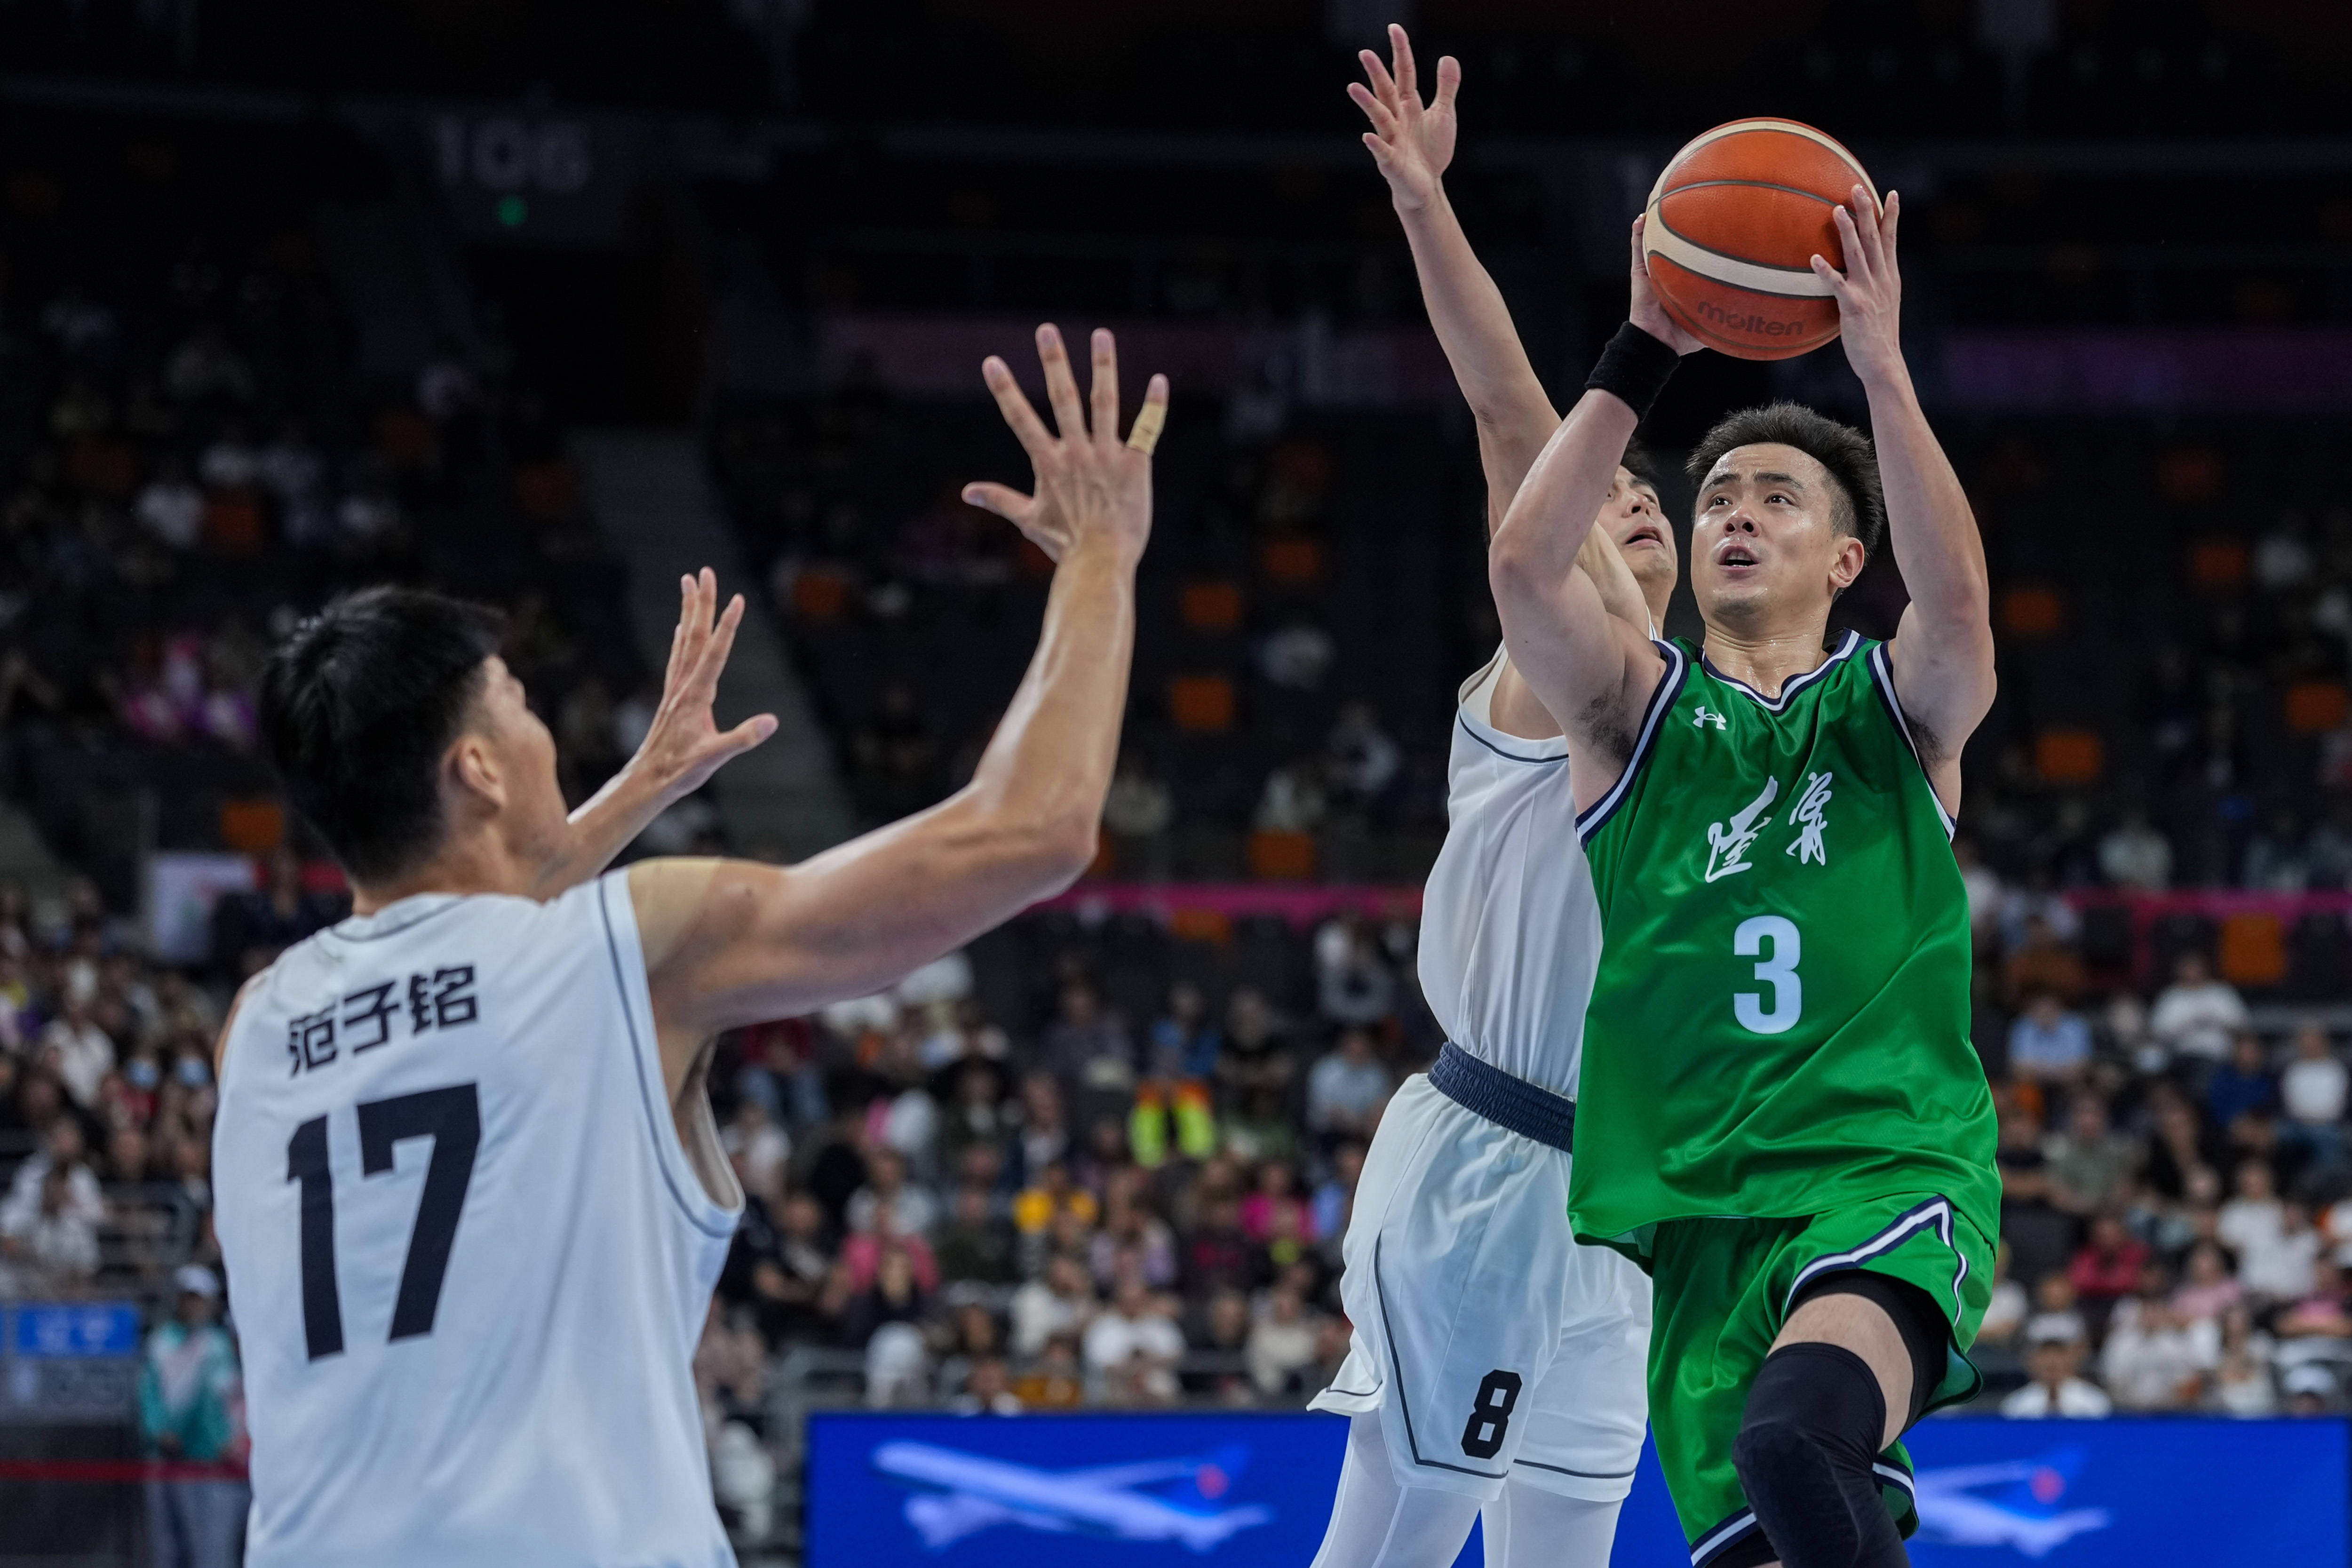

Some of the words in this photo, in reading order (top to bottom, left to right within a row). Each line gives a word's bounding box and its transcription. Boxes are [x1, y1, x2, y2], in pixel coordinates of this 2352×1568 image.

[1697, 301, 1804, 336] molten
[289, 965, 477, 1076] 范子铭
[1733, 915, 1802, 1035] 3
[286, 1082, 481, 1363] 17
[1461, 1369, 1522, 1460] 8
